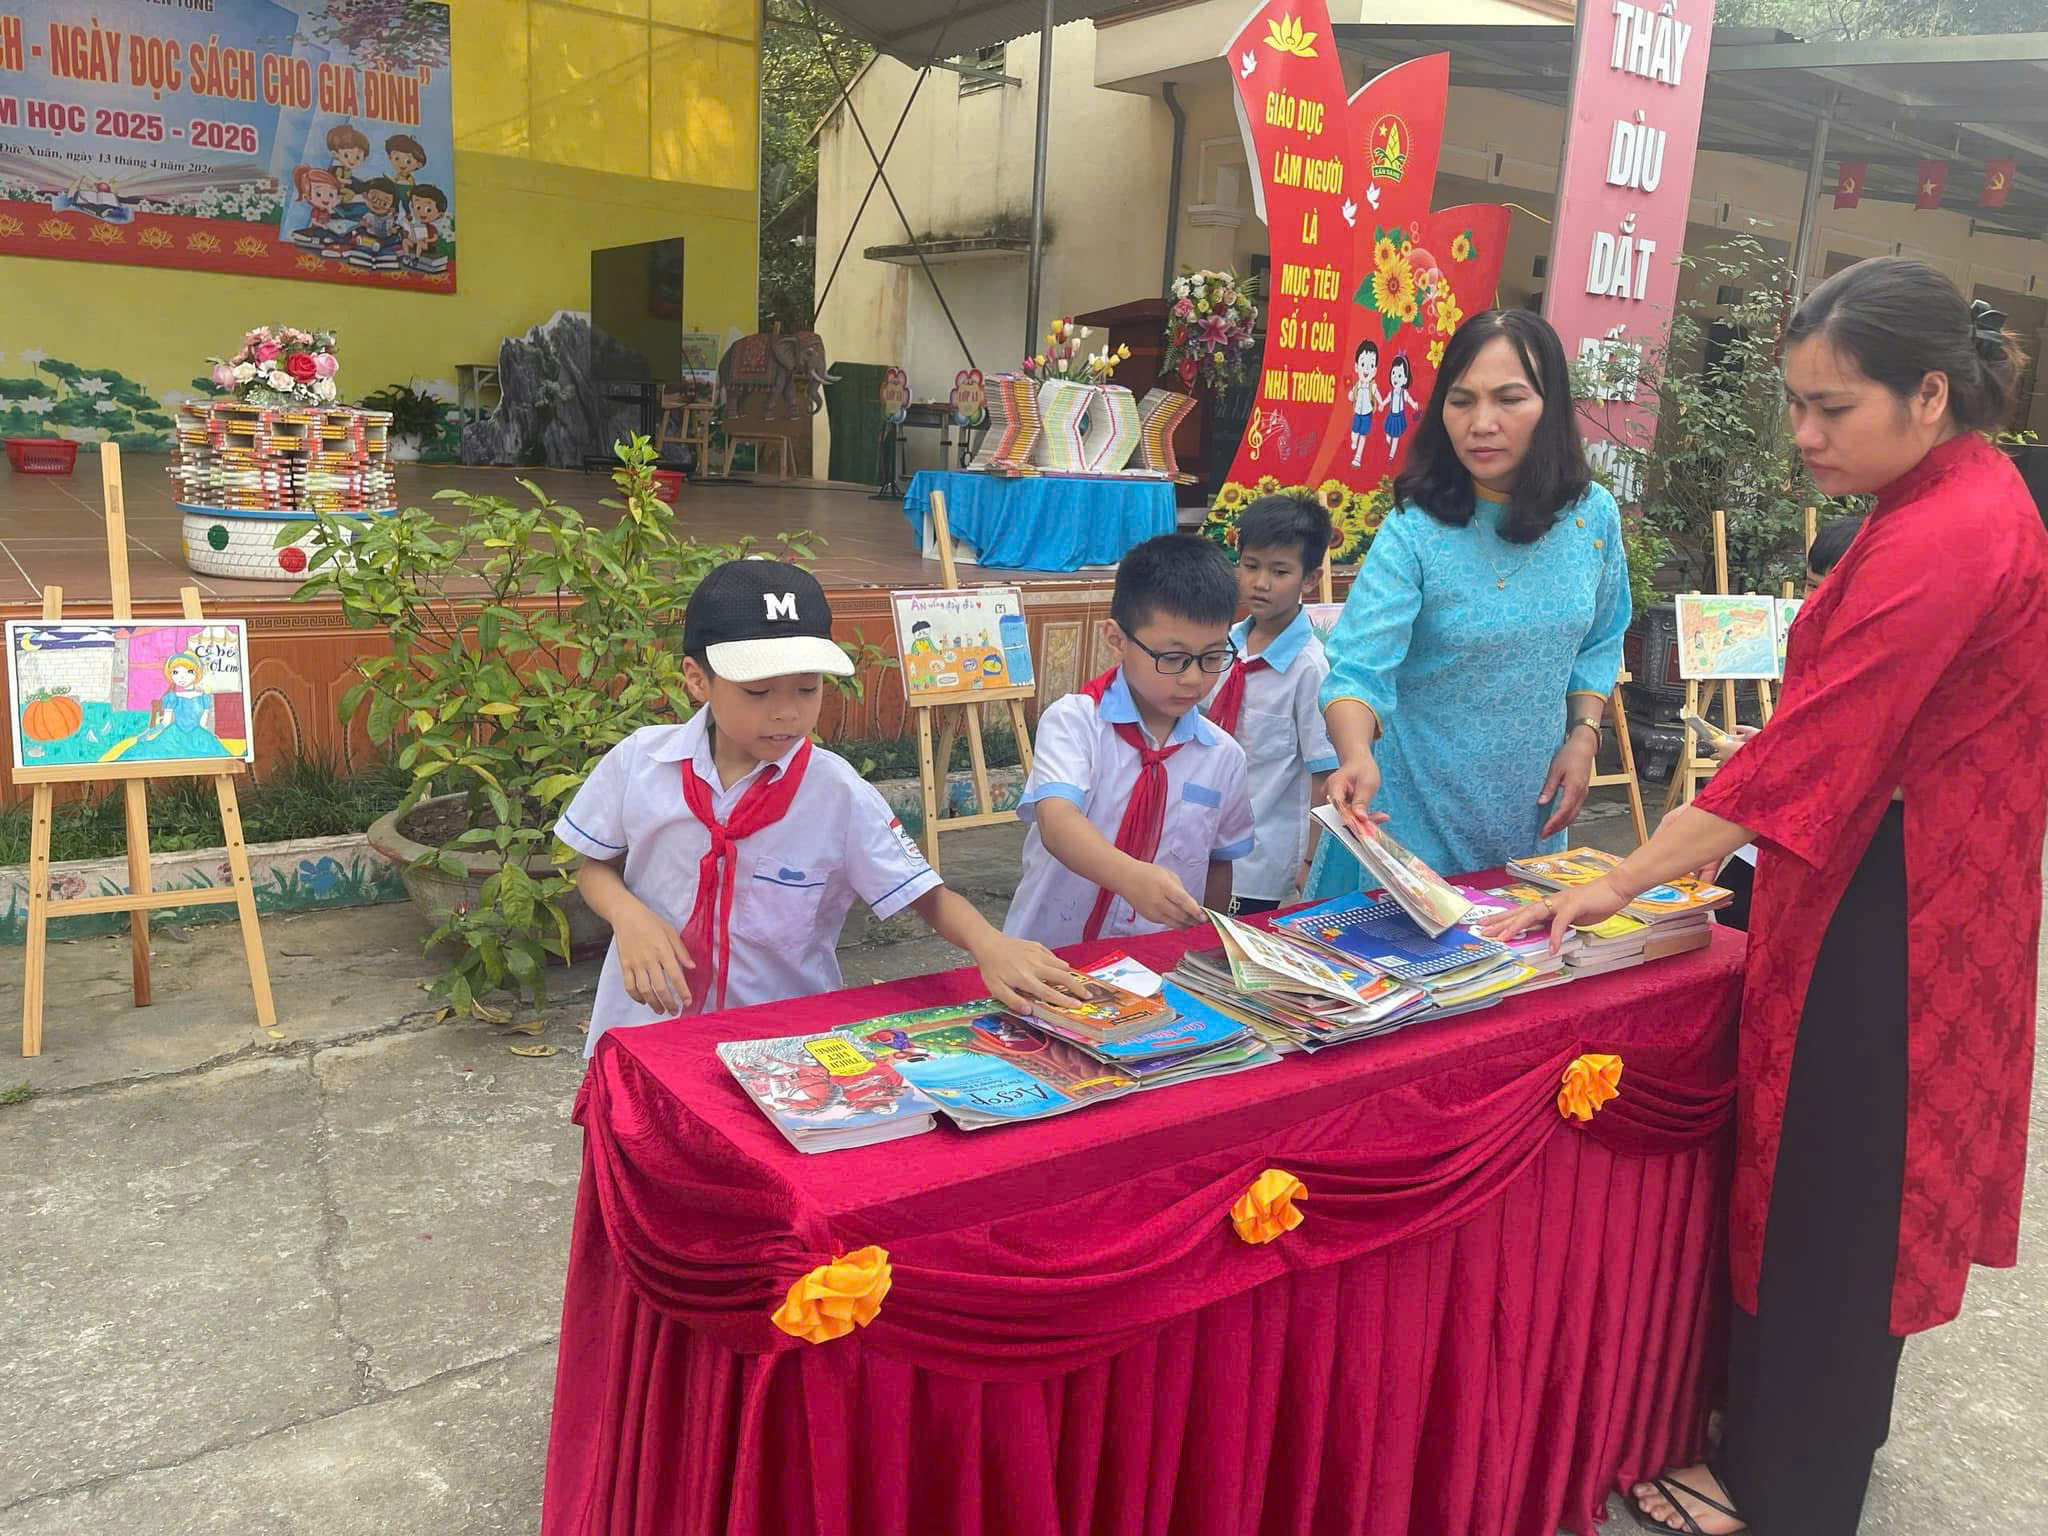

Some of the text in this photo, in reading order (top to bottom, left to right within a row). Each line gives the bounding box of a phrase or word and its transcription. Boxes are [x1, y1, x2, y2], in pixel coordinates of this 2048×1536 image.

[1610, 0, 1692, 86] THẦY
[0, 16, 23, 71] H
[50, 17, 121, 83] NGÀY
[129, 34, 182, 100] ĐỌC
[189, 35, 256, 101] SÁCH
[263, 53, 312, 110] CHO
[318, 62, 359, 118] GIA
[27, 100, 86, 136] HỌC
[95, 109, 163, 142] 2025
[192, 120, 257, 153] 2026
[1266, 88, 1324, 141] GIÁO DỤC
[66, 151, 93, 164] ngày
[99, 153, 111, 163] 13
[115, 154, 147, 169] tháng
[150, 159, 157, 168] 4
[160, 160, 185, 172] năm
[1273, 145, 1344, 195] LÀM NGƯỜI
[1606, 109, 1666, 193] DÌU
[1302, 207, 1318, 245] LÀ
[1585, 212, 1657, 301] DẮT
[1280, 263, 1340, 303] MỤC TIÊU
[1279, 308, 1335, 352] SỐ 1 CỦA
[1264, 364, 1336, 404] NHÀ TRƯỜNG
[763, 592, 800, 621] M
[966, 1084, 1049, 1106] Aesop
